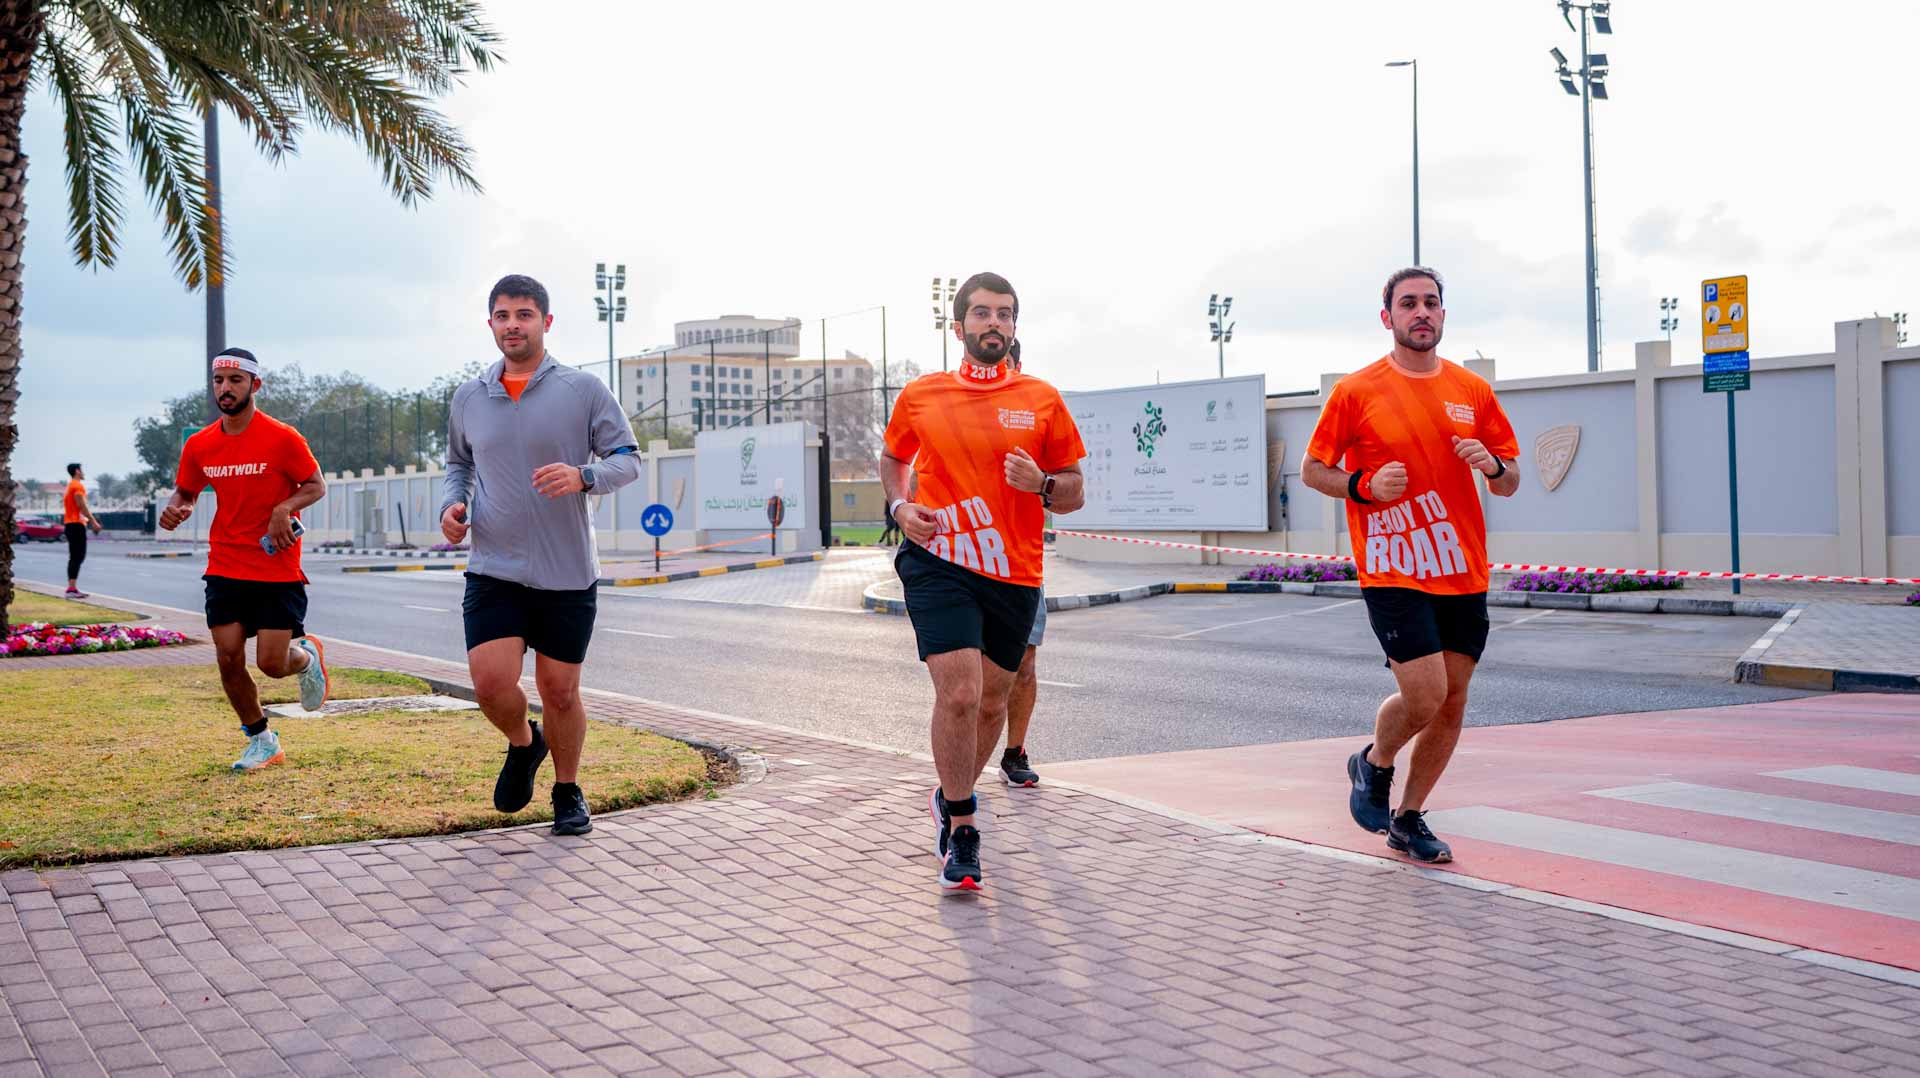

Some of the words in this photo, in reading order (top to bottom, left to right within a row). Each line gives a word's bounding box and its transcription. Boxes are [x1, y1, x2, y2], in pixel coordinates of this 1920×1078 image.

[203, 463, 268, 478] SQUATWOLF
[960, 496, 993, 529] TO
[1414, 490, 1448, 523] TO
[927, 527, 1011, 578] OAR
[1366, 521, 1468, 579] ROAR
